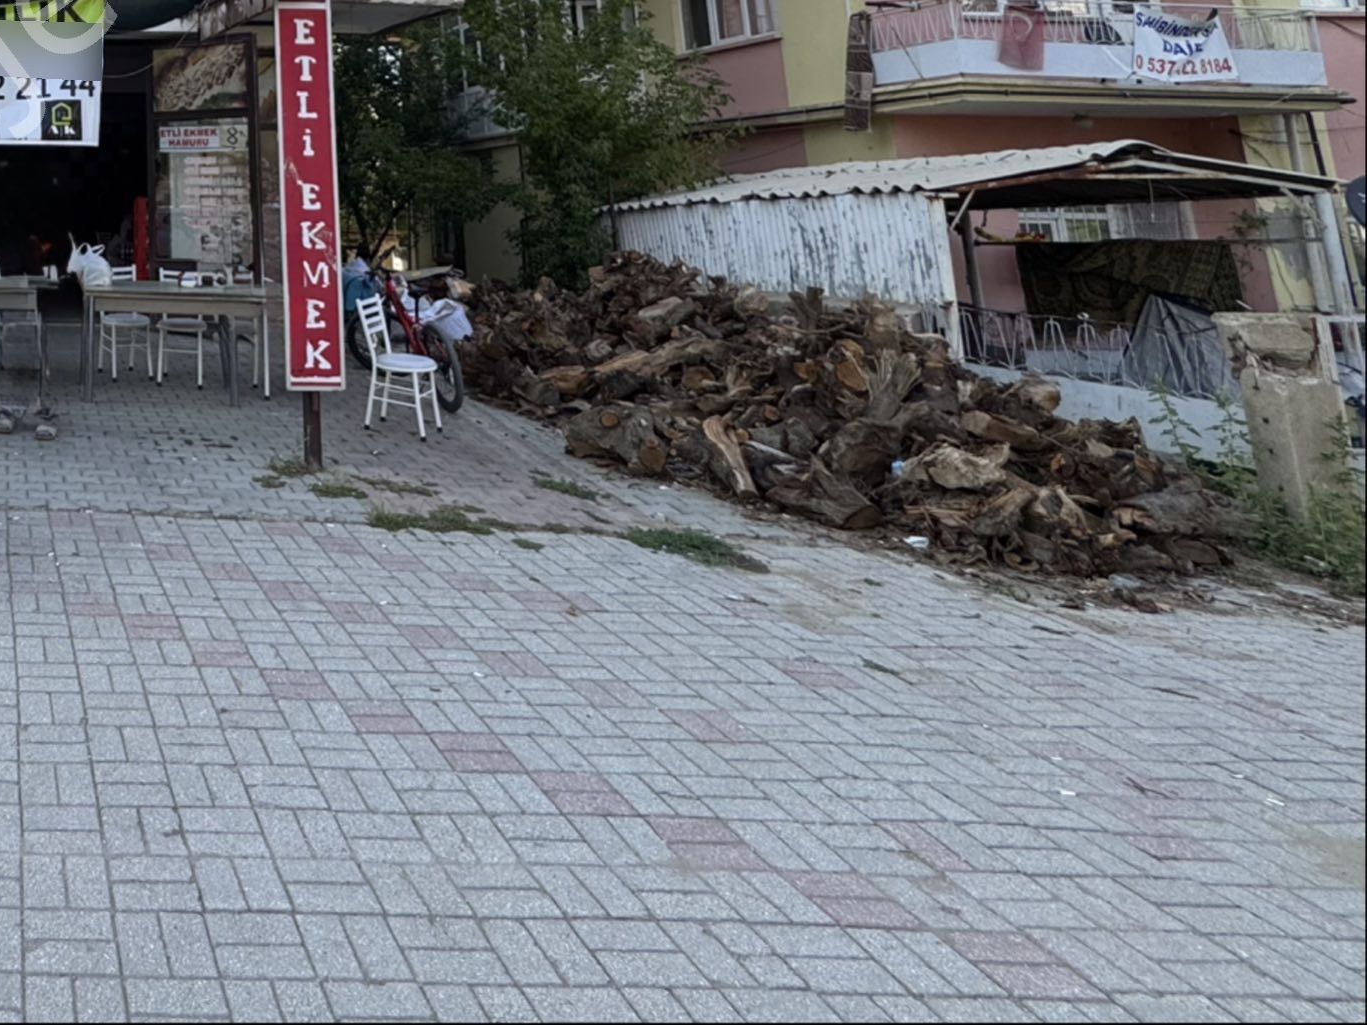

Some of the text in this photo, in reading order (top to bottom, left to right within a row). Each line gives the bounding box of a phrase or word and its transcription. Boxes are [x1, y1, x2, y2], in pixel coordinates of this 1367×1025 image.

[1136, 54, 1144, 70] 0
[16, 76, 51, 99] 21
[59, 78, 96, 97] 44
[300, 182, 332, 370] EKMEK
